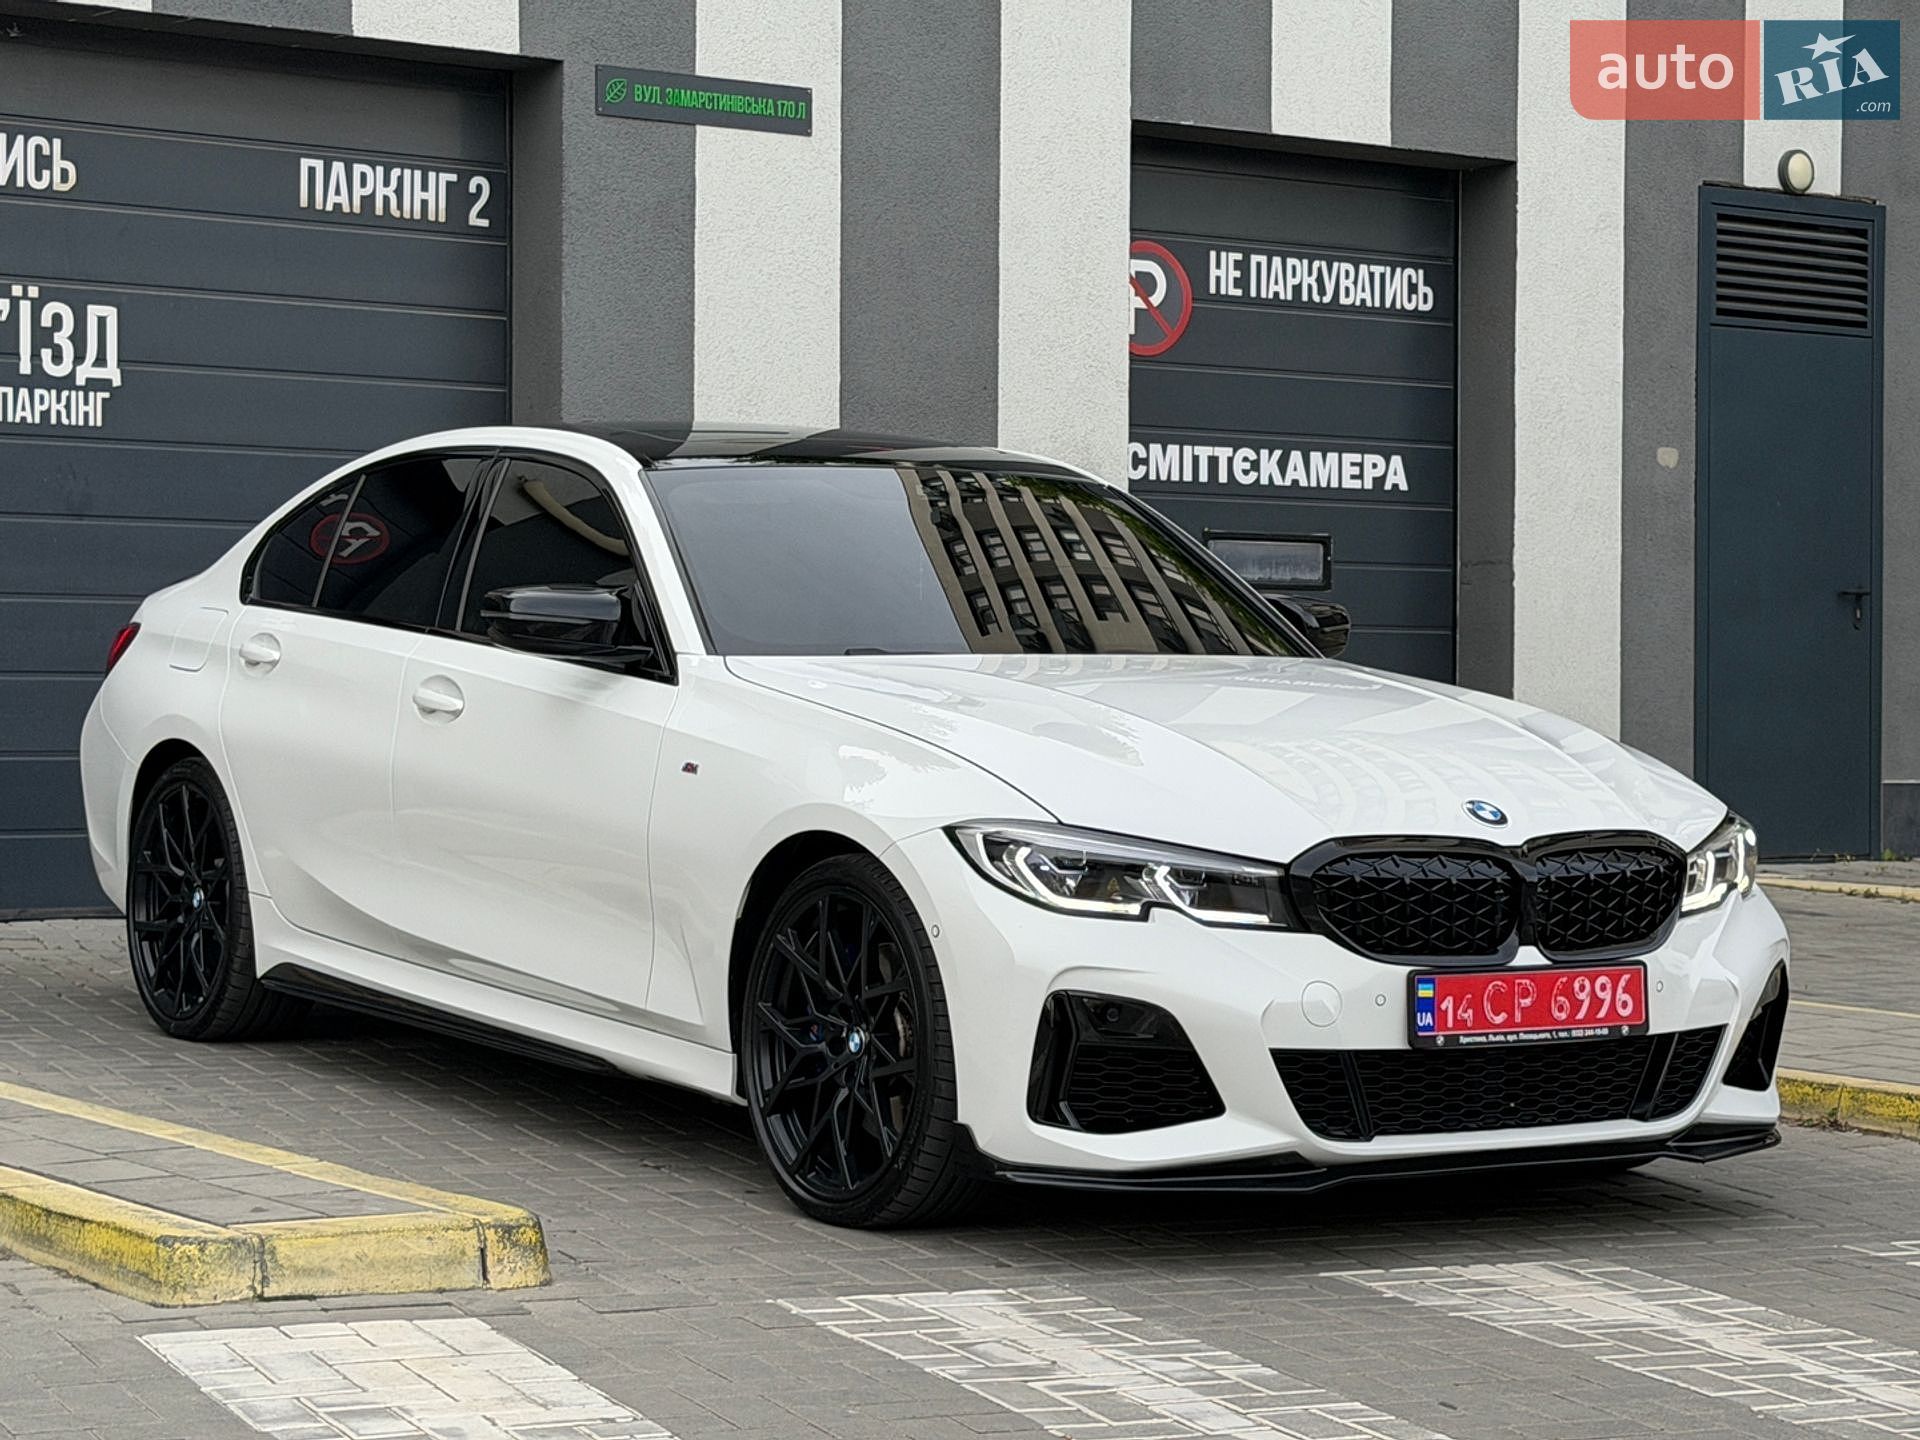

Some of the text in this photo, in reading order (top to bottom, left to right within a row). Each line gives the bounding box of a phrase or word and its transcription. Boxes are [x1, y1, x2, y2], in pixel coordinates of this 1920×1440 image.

[634, 84, 663, 105] ВУЛ.
[665, 88, 775, 117] ЗАМАРСТИНІВСЬКА
[0, 132, 77, 192] ИСЬ
[299, 157, 491, 228] ПАРКІНГ 2
[1209, 250, 1434, 312] НЕ ПАРКУВАТИСЬ
[0, 386, 111, 428] ПАРКІНГ
[1128, 442, 1409, 492] СМІТТЄКАМЕРА
[1417, 1012, 1433, 1026] UA
[1440, 995, 1474, 1028] 14
[1551, 974, 1634, 1021] 6996
